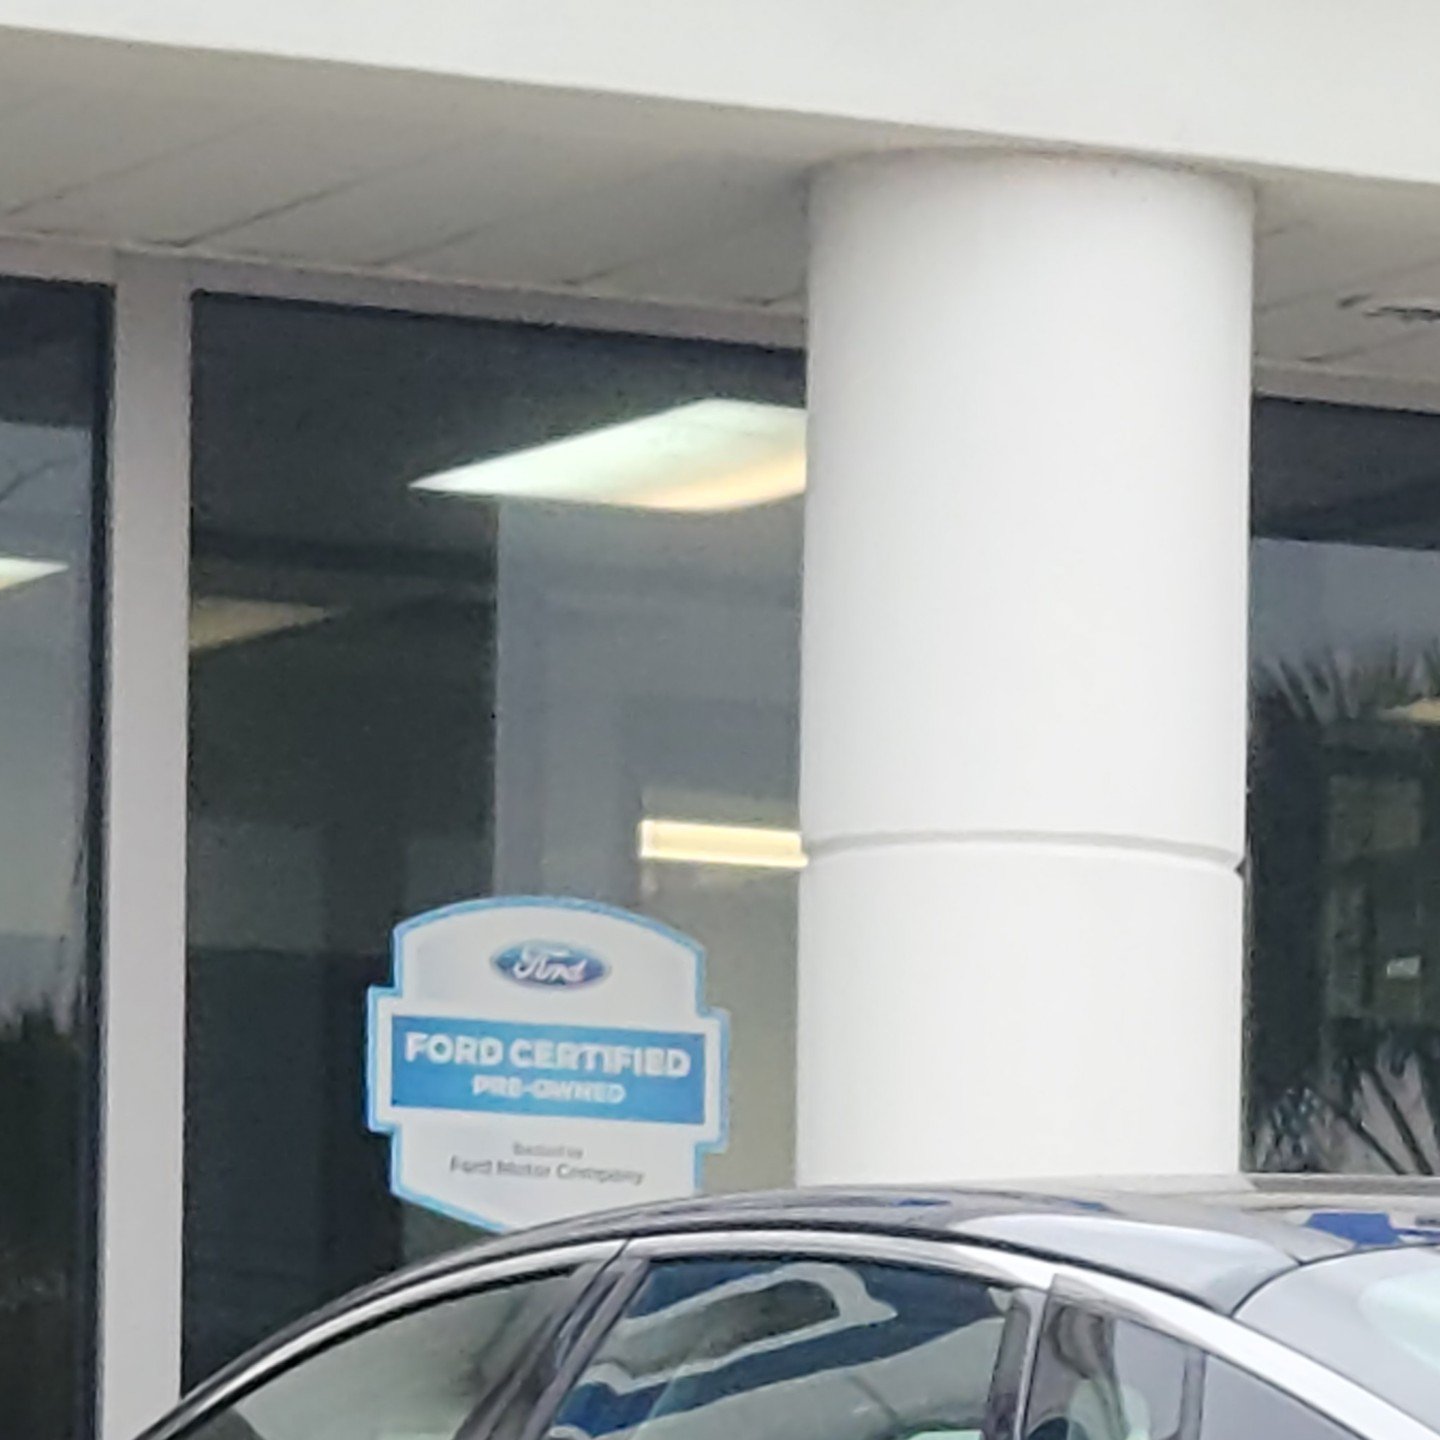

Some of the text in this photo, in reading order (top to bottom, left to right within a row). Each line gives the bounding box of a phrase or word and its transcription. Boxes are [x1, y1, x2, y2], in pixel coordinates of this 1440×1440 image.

[513, 945, 587, 983] Ford
[404, 1031, 692, 1079] FORD CERTIFIED
[471, 1075, 626, 1105] PRE-OWNED
